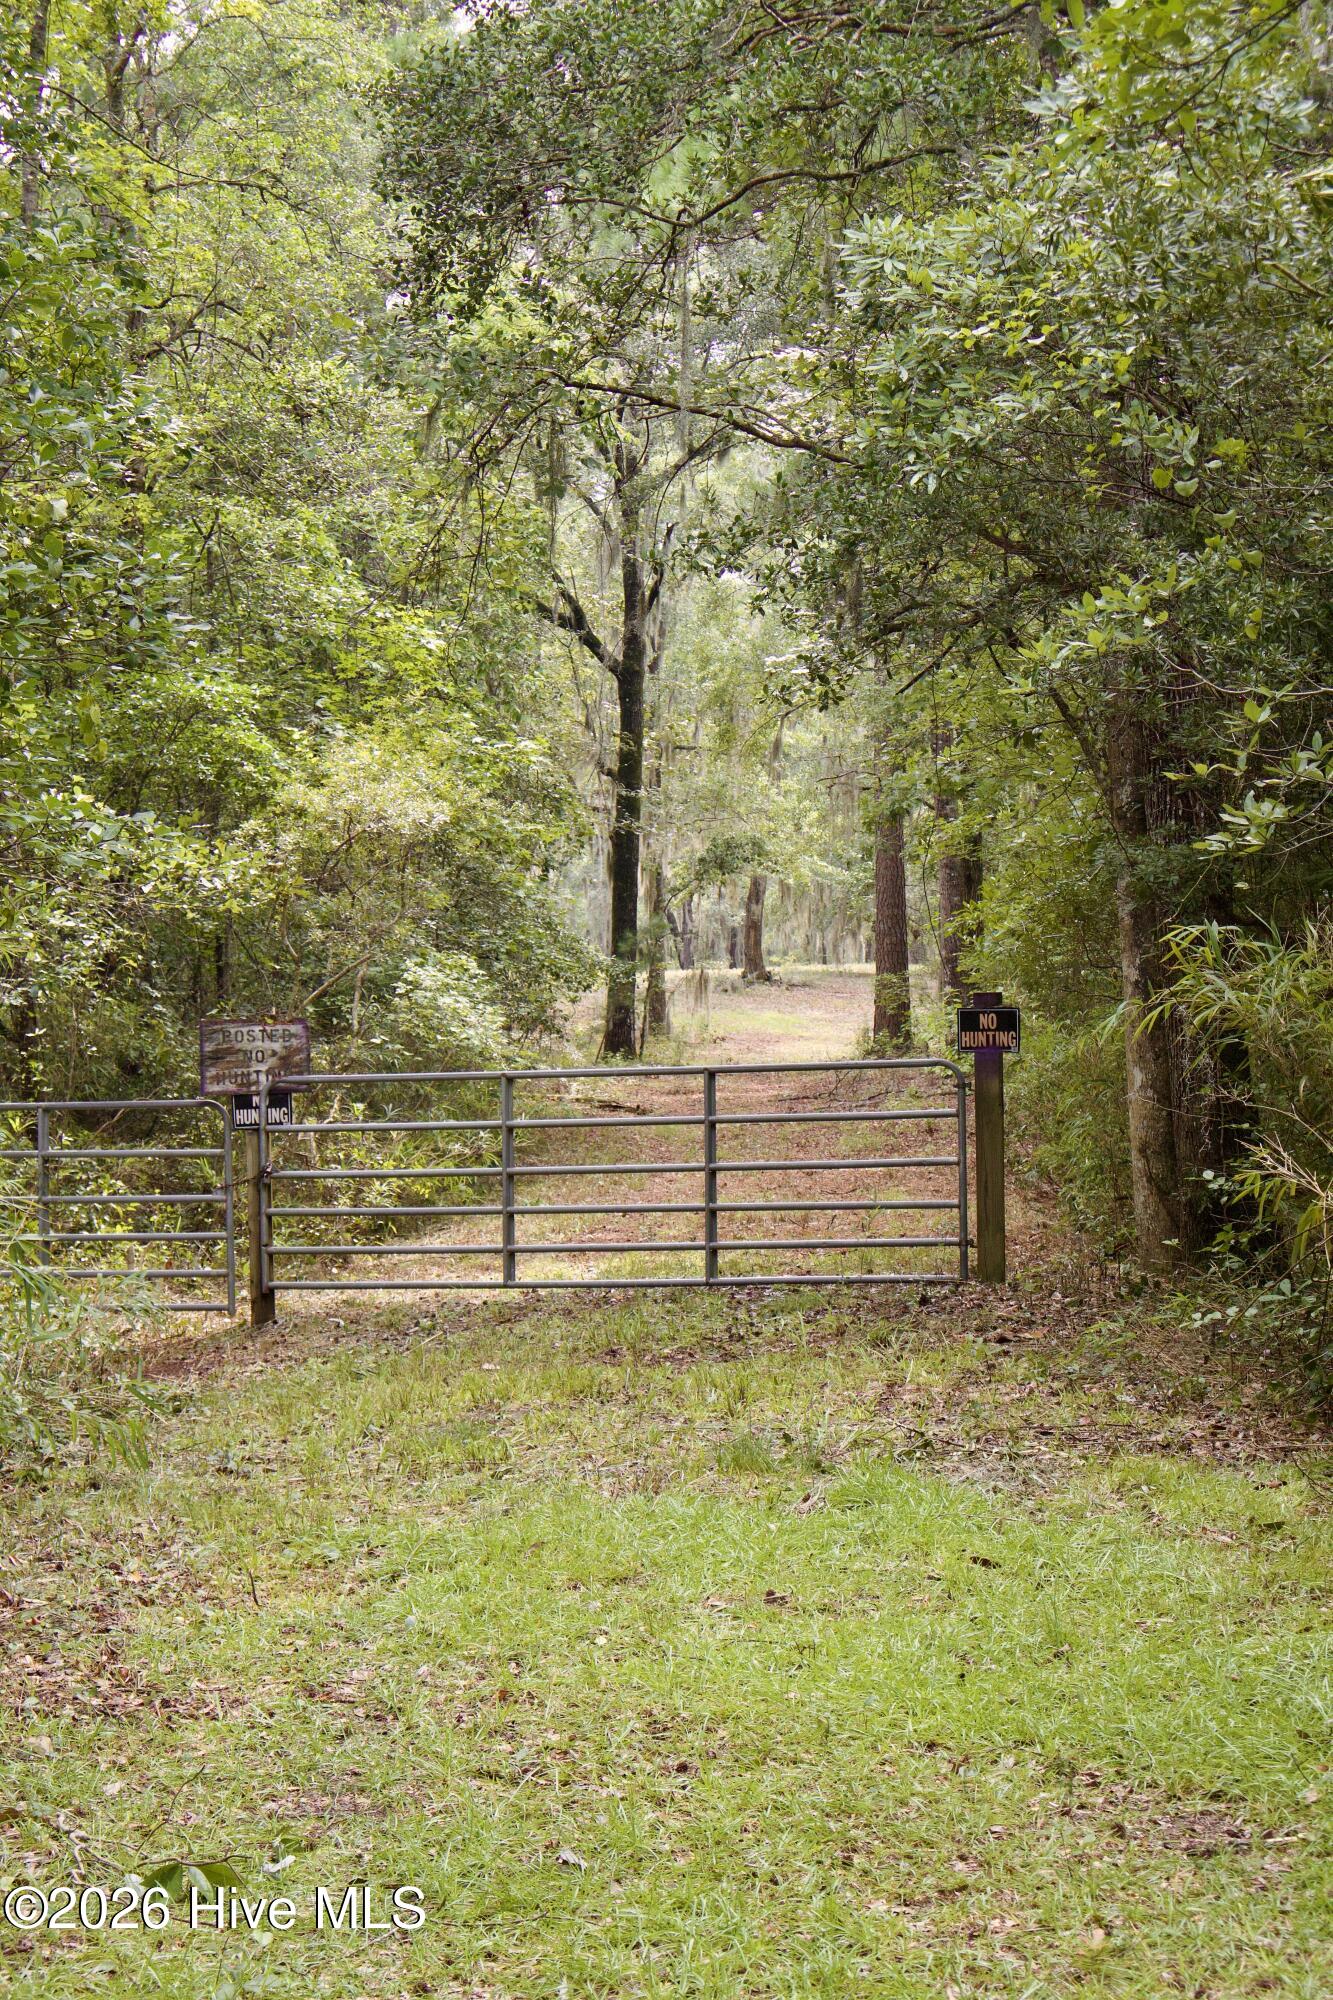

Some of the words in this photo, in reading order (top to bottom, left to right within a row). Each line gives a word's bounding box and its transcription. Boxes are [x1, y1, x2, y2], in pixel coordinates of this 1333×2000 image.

[979, 1013, 997, 1029] NO
[222, 1028, 292, 1043] POSTED
[961, 1031, 1016, 1047] HUNTING
[244, 1049, 265, 1063] NO
[215, 1069, 284, 1085] HUNTIN
[252, 1095, 269, 1107] N
[235, 1107, 288, 1124] HUNING
